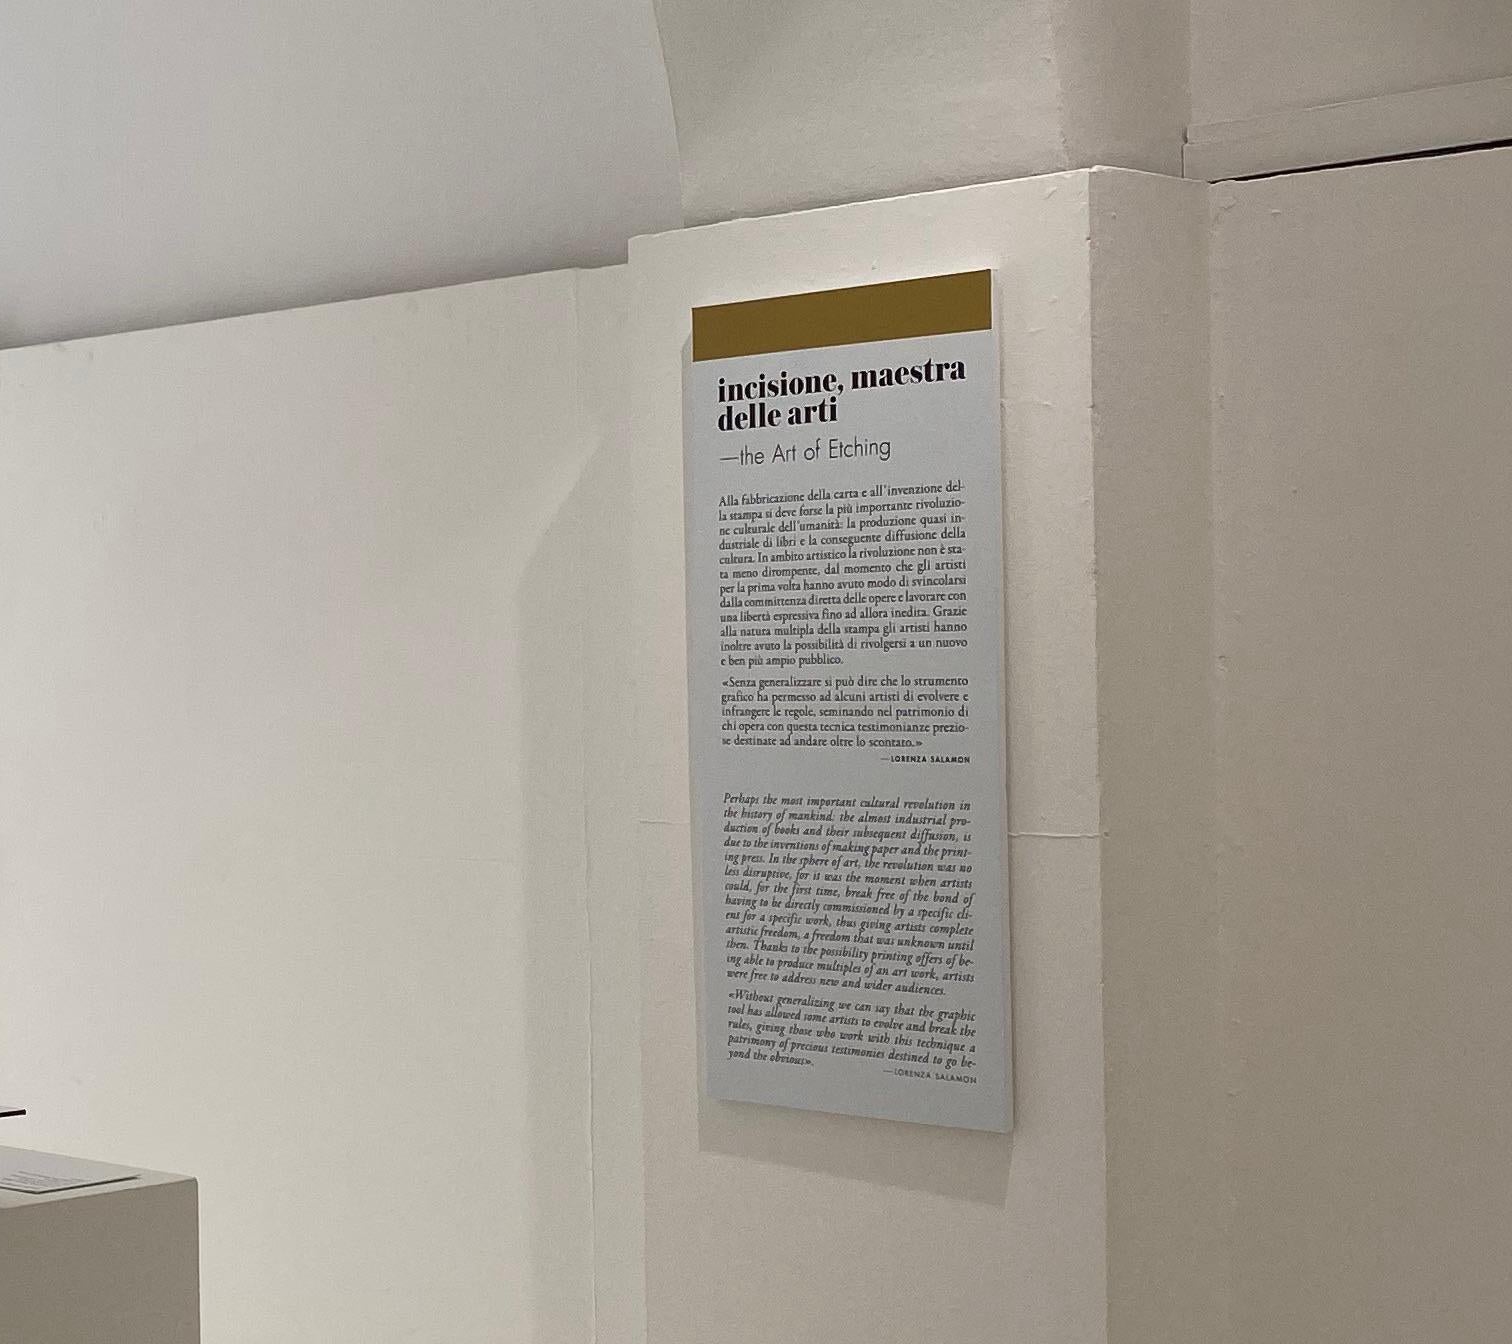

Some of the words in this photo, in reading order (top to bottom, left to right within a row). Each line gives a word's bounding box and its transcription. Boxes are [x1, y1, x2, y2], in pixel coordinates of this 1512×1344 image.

[718, 370, 844, 403] incisione,
[851, 357, 966, 390] maestra
[717, 403, 782, 432] delle
[787, 396, 838, 423] arti
[771, 441, 797, 464] Art
[803, 439, 821, 461] of
[829, 436, 891, 462] Etching
[719, 493, 738, 506] Alla
[740, 491, 804, 504] fabbricazione
[806, 488, 831, 501] della
[833, 489, 859, 499] carta
[860, 490, 867, 498] e
[718, 508, 727, 520] la
[729, 510, 762, 522] stampa
[764, 506, 772, 518] si
[774, 505, 797, 517] deve
[798, 504, 823, 516] forse
[824, 503, 834, 515] la
[836, 501, 853, 518] più
[855, 501, 913, 516] importante
[719, 527, 730, 535] ne
[732, 521, 775, 534] culturale
[846, 517, 856, 529] la
[858, 515, 916, 532] produzione
[918, 513, 947, 529] quasi
[718, 536, 760, 549] dustriale
[762, 535, 773, 547] di
[775, 535, 796, 547] libri
[799, 538, 805, 546] e
[807, 534, 817, 545] la
[819, 533, 881, 547] conseguente
[883, 529, 937, 542] diffusione
[940, 527, 965, 540] della
[757, 550, 768, 562] In
[769, 549, 804, 562] ambito
[805, 548, 847, 561] artistico
[847, 547, 857, 559] la
[858, 546, 916, 559] rivoluzione
[916, 547, 938, 556] non
[938, 543, 946, 555] è
[719, 569, 728, 578] ta
[732, 569, 758, 578] meno
[823, 562, 840, 575] dal
[843, 563, 892, 574] momento
[892, 560, 913, 572] che
[916, 559, 930, 575] gli
[934, 558, 966, 571] artisti
[719, 584, 734, 596] per
[736, 580, 745, 592] la
[746, 580, 775, 595] prima
[777, 579, 801, 591] volta
[802, 578, 835, 590] hanno
[836, 579, 865, 589] avuto
[866, 576, 897, 588] modo
[898, 575, 909, 587] di
[911, 574, 966, 587] svincolarsi
[720, 624, 737, 636] alla
[739, 626, 771, 636] natura
[773, 623, 814, 638] multipla
[816, 622, 841, 635] della
[843, 625, 880, 637] stampa
[882, 621, 896, 637] gli
[898, 621, 930, 633] artisti
[930, 620, 967, 633] hanno
[720, 658, 727, 666] e
[727, 654, 747, 665] ben
[747, 654, 764, 669] più
[764, 654, 797, 669] ampio
[758, 675, 822, 690] generalizzare
[824, 675, 832, 687] si
[834, 675, 854, 690] può
[856, 674, 877, 686] dire
[879, 674, 898, 686] che
[900, 674, 911, 686] lo
[913, 677, 968, 686] strumento
[720, 690, 754, 705] grafico
[756, 690, 770, 701] ha
[769, 694, 816, 705] permesso
[818, 690, 831, 702] ad
[833, 690, 866, 702] alcuni
[868, 690, 900, 702] artisti
[902, 690, 914, 702] di
[916, 690, 959, 702] evolvere
[962, 694, 968, 702] e
[721, 704, 770, 720] infrangere
[772, 704, 781, 716] le
[818, 705, 874, 717] seminando
[876, 705, 892, 717] nel
[895, 705, 955, 721] patrimonio
[957, 705, 968, 717] di
[721, 719, 737, 730] chi
[737, 723, 765, 734] opera
[766, 723, 784, 731] con
[785, 722, 818, 735] questa
[819, 720, 855, 732] tecnica
[856, 720, 930, 732] testimonianze
